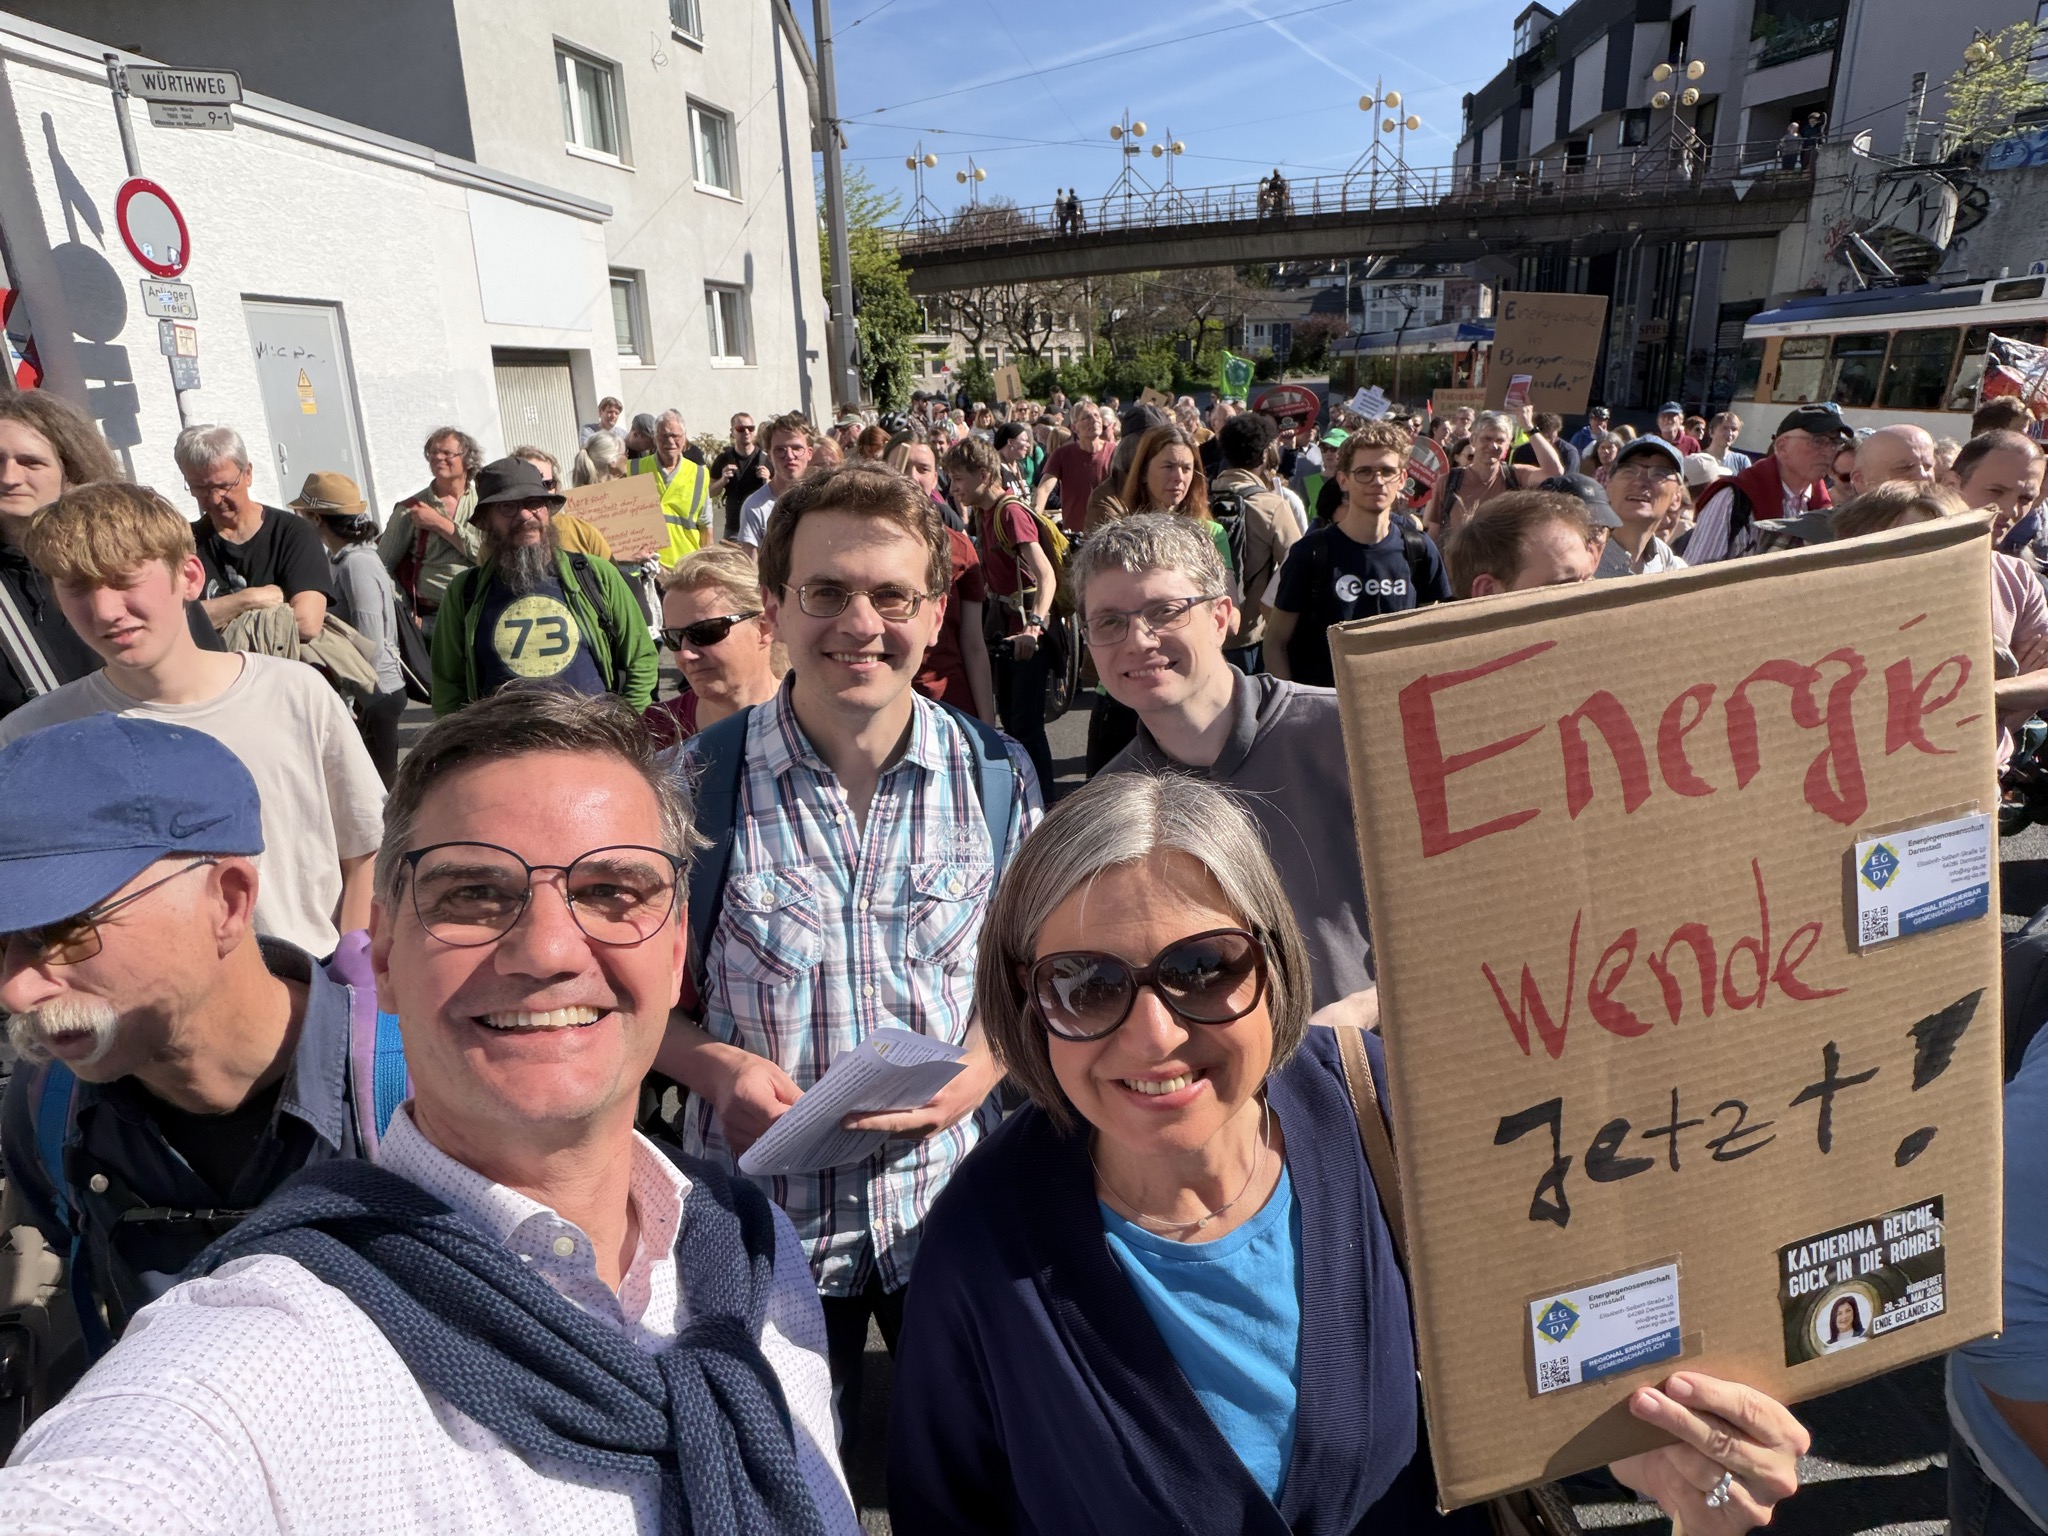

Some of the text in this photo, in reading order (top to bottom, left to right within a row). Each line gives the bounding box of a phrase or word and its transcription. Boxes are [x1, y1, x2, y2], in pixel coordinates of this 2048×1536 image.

[142, 72, 226, 94] WÜRTHWEG
[208, 112, 230, 125] 9-1
[1365, 578, 1406, 596] esa
[504, 616, 570, 660] 73
[1908, 824, 1984, 847] Energiegenossenschaft
[1872, 852, 1888, 866] EG
[1908, 842, 1942, 856] Darmstadt
[1872, 869, 1889, 881] DA
[1906, 888, 1982, 920] REGIONAL ERNEUERBAR
[1913, 899, 1976, 925] GEMEINSCHAFTLICH
[1481, 858, 1849, 1059] Wende
[1788, 1204, 1940, 1273] KATHERINA REICHE,
[1789, 1229, 1940, 1298] GUCK IN DIE RÖHRE!
[1588, 1274, 1671, 1302] Energiegenossenschaft
[1906, 1274, 1942, 1294] RUHRGEBIET
[1910, 1290, 1925, 1304] MAI
[1926, 1284, 1942, 1298] 2026
[1590, 1294, 1626, 1310] Darmstadt
[1646, 1302, 1674, 1314] Darmstadt
[1548, 1308, 1568, 1322] EG
[1635, 1310, 1675, 1325] info@eg-da.de
[1637, 1316, 1676, 1331] www.eg-da.de
[1874, 1316, 1894, 1331] ENDE
[1550, 1324, 1568, 1336] DA
[1589, 1332, 1672, 1367] REGIONAL ERNEUERBAR
[1598, 1342, 1665, 1372] GEMEINSCHAFTLICH
